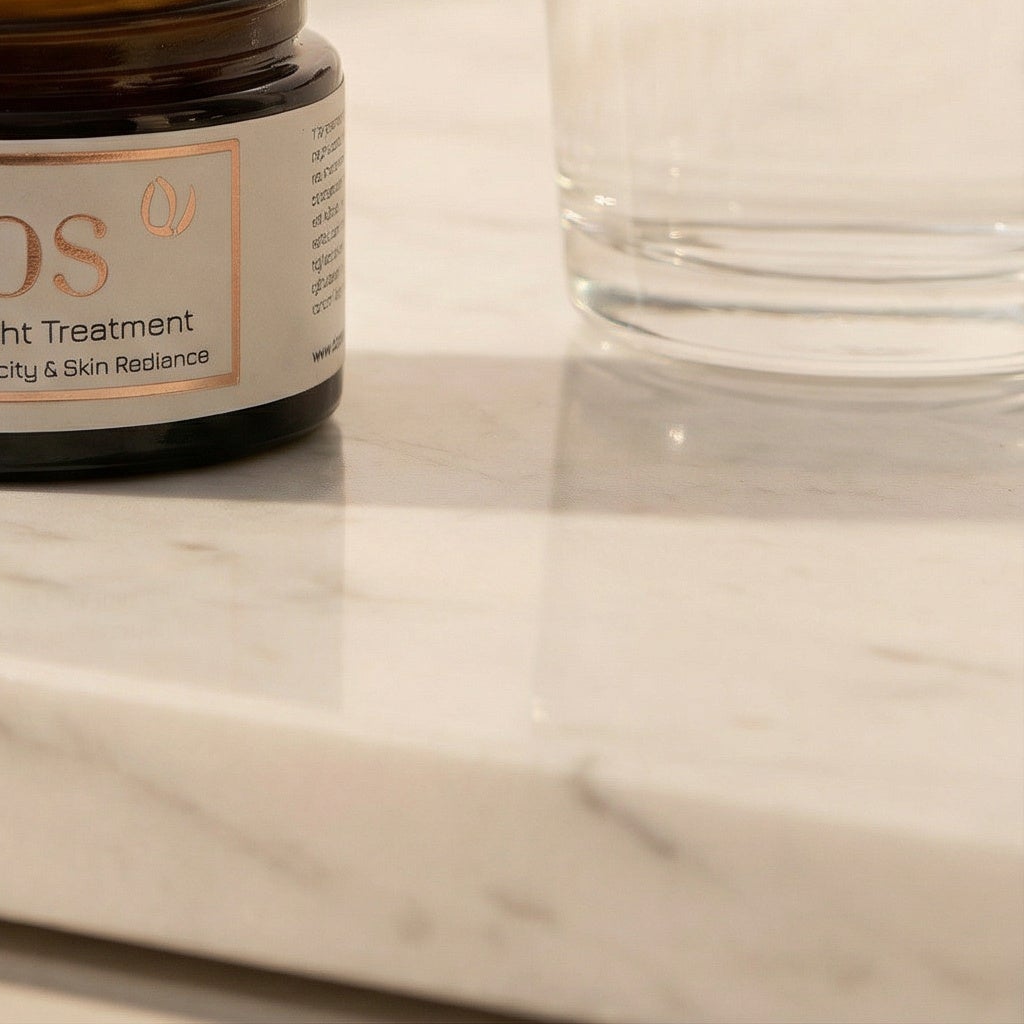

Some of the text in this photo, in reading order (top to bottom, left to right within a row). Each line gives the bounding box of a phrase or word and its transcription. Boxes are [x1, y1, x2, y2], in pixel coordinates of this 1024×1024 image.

[41, 309, 194, 344] Treatment
[43, 360, 58, 379] &
[63, 357, 109, 378] Skin
